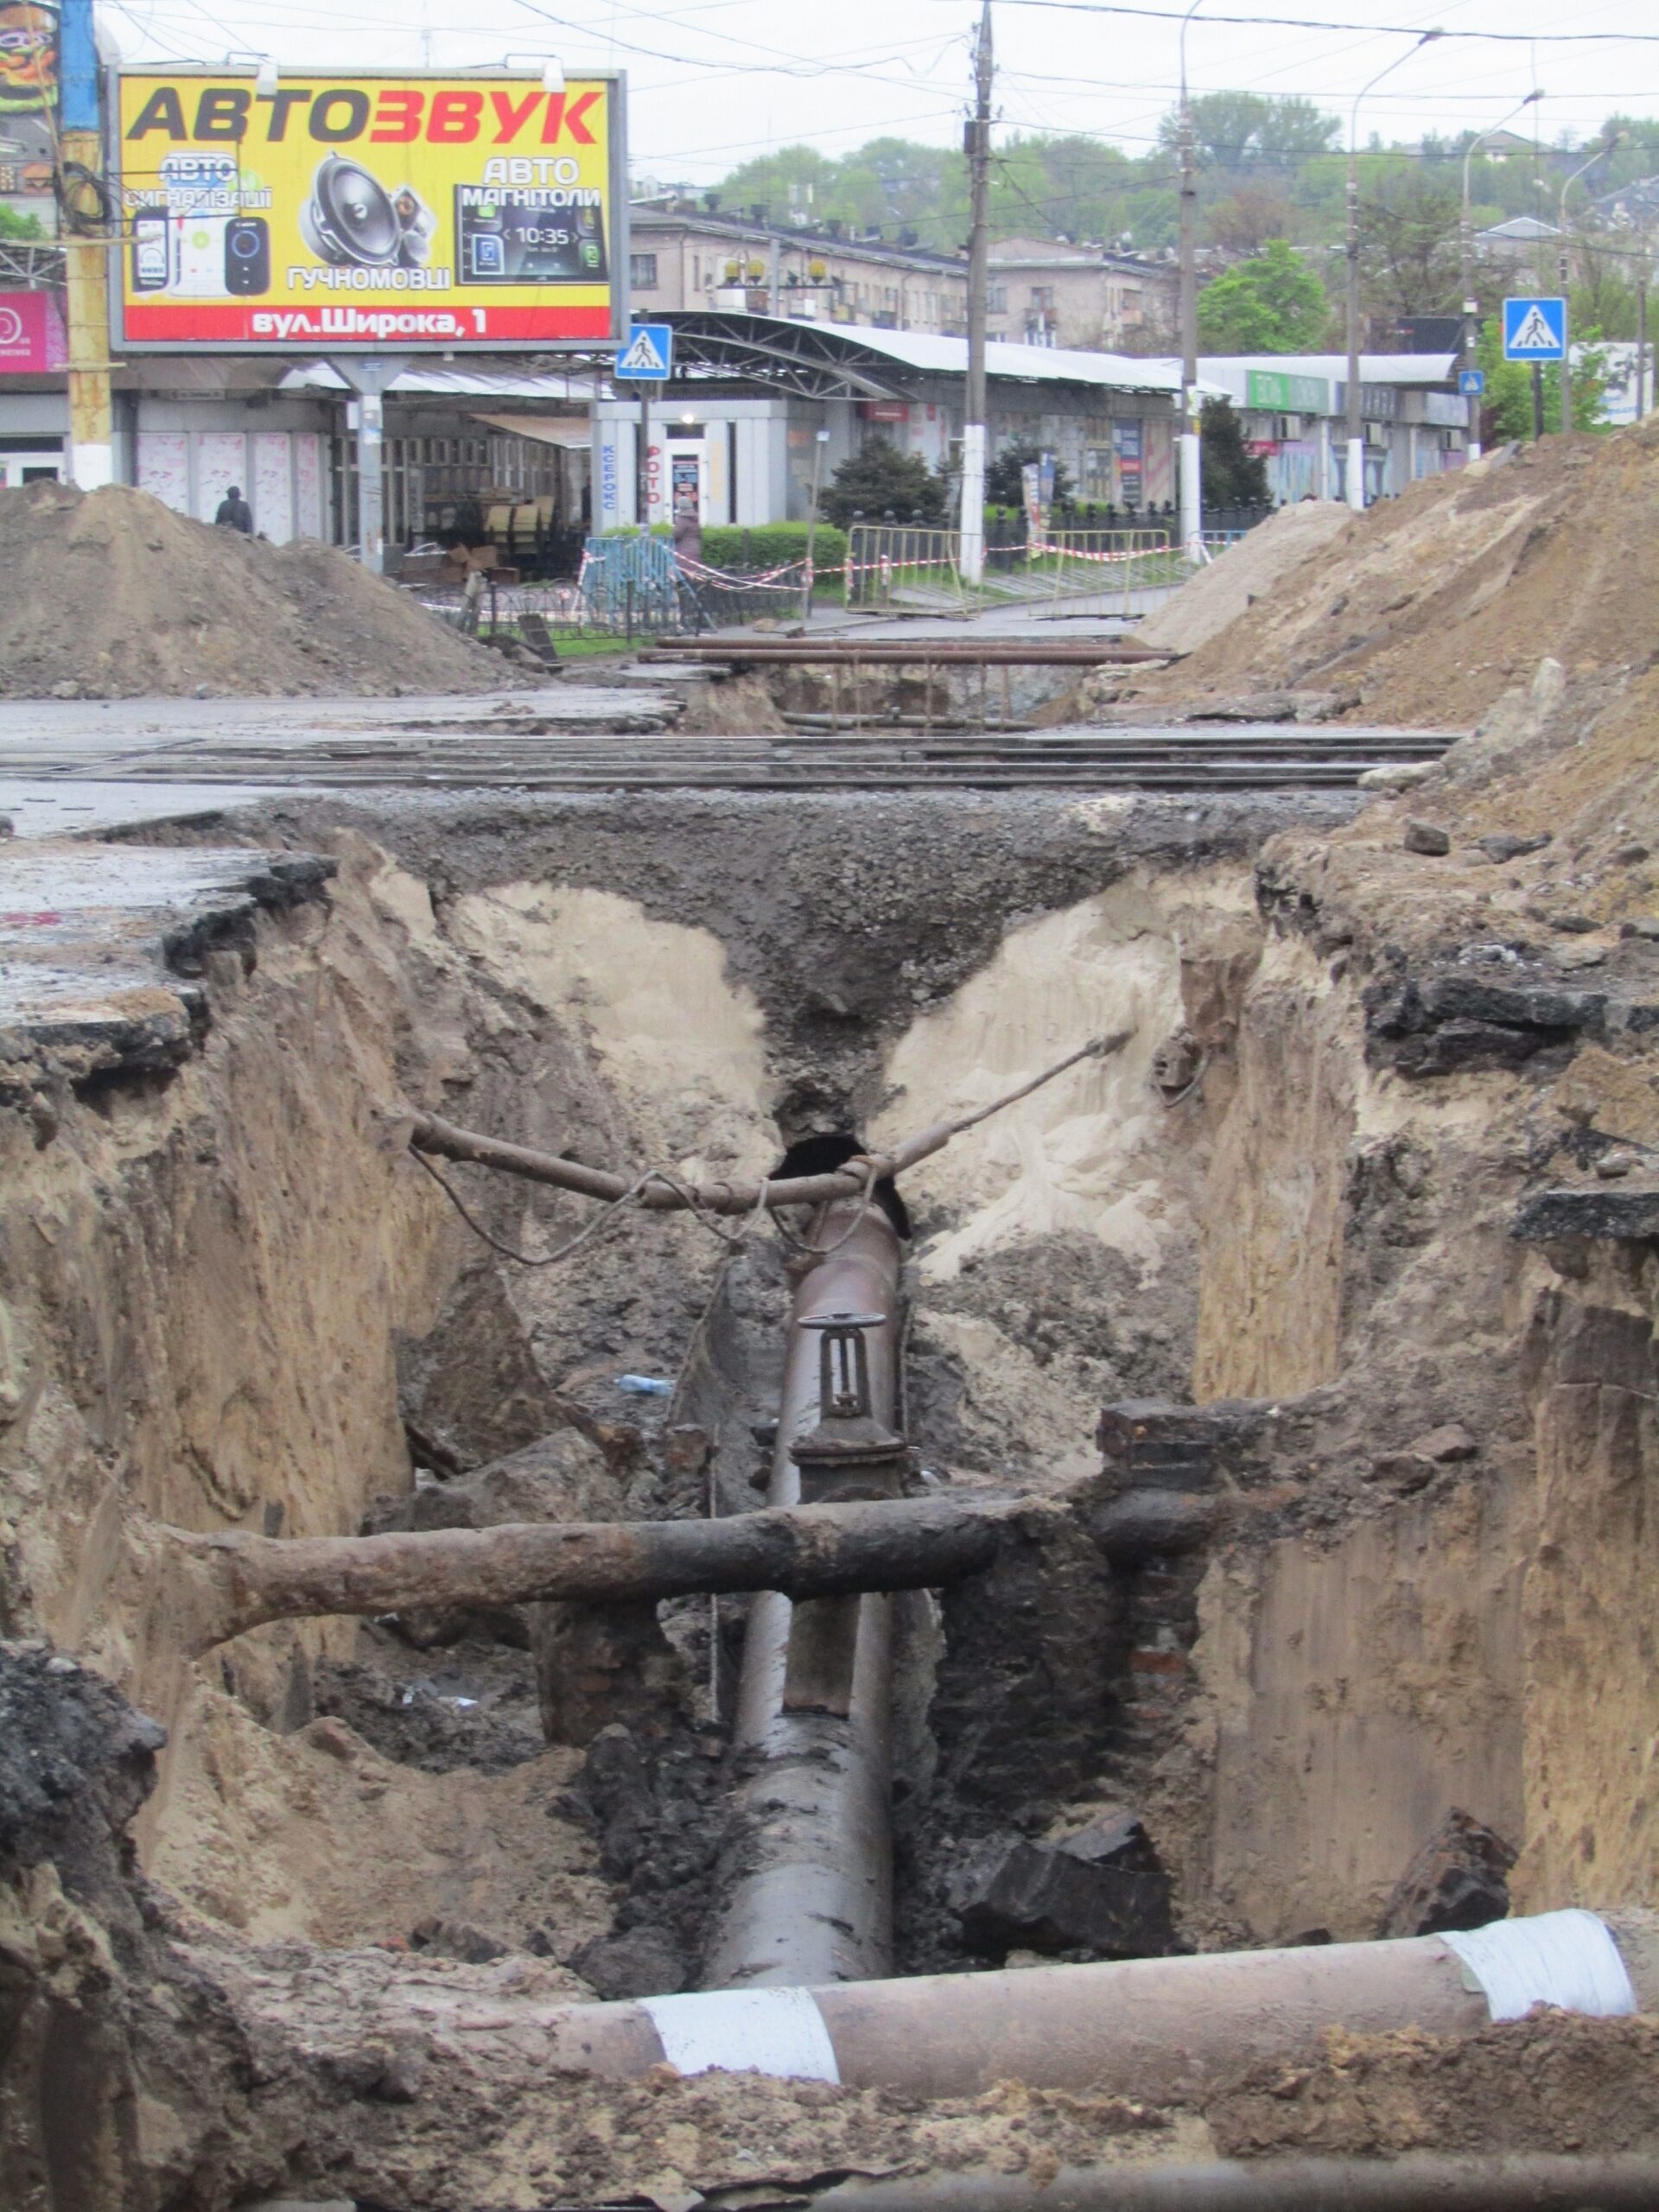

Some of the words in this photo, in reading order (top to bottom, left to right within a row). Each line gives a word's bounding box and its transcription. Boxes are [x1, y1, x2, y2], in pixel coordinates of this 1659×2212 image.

[125, 87, 605, 144] АВТОЗВУК
[159, 156, 236, 182] АВТО
[482, 157, 581, 185] АВТО
[461, 188, 601, 207] МАГНІТОЛИ
[516, 227, 569, 245] 10:35
[287, 267, 451, 290] ГУЧНОМОВЦІ
[472, 308, 486, 333] 1
[603, 445, 615, 510] КСЕРОКС
